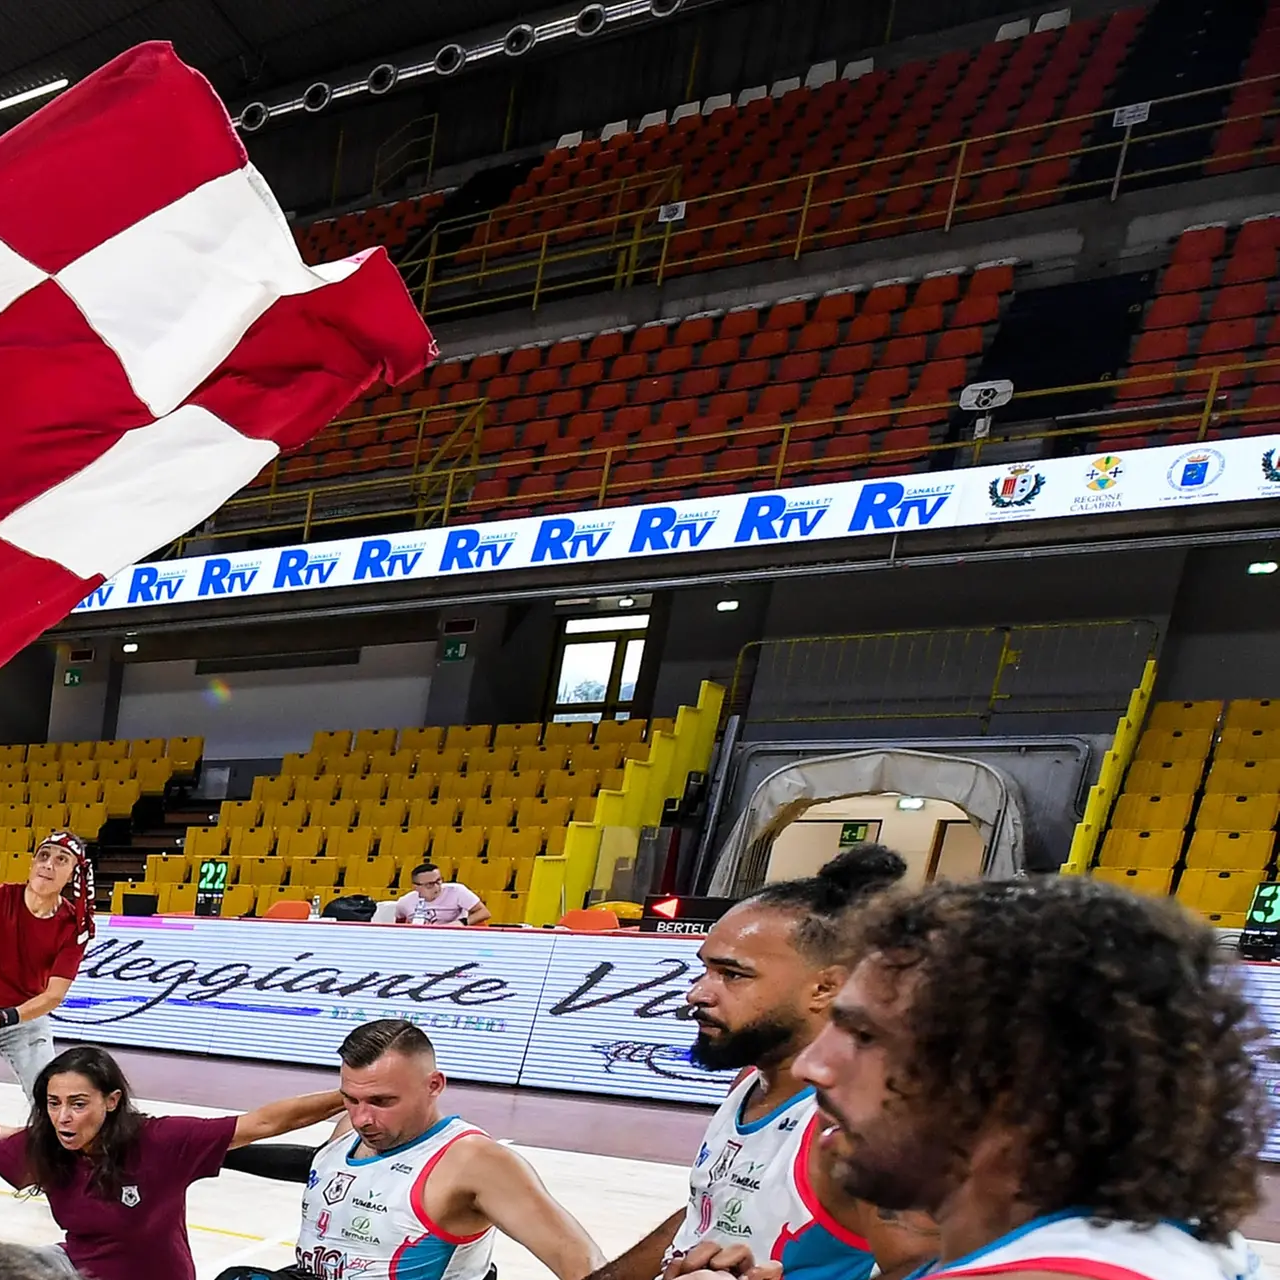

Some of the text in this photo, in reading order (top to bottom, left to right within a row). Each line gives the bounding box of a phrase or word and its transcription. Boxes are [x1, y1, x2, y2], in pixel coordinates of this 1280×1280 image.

[1070, 501, 1123, 512] CALABRIA
[1073, 493, 1123, 504] REGIONE
[77, 586, 115, 608] TV
[199, 863, 227, 889] 22
